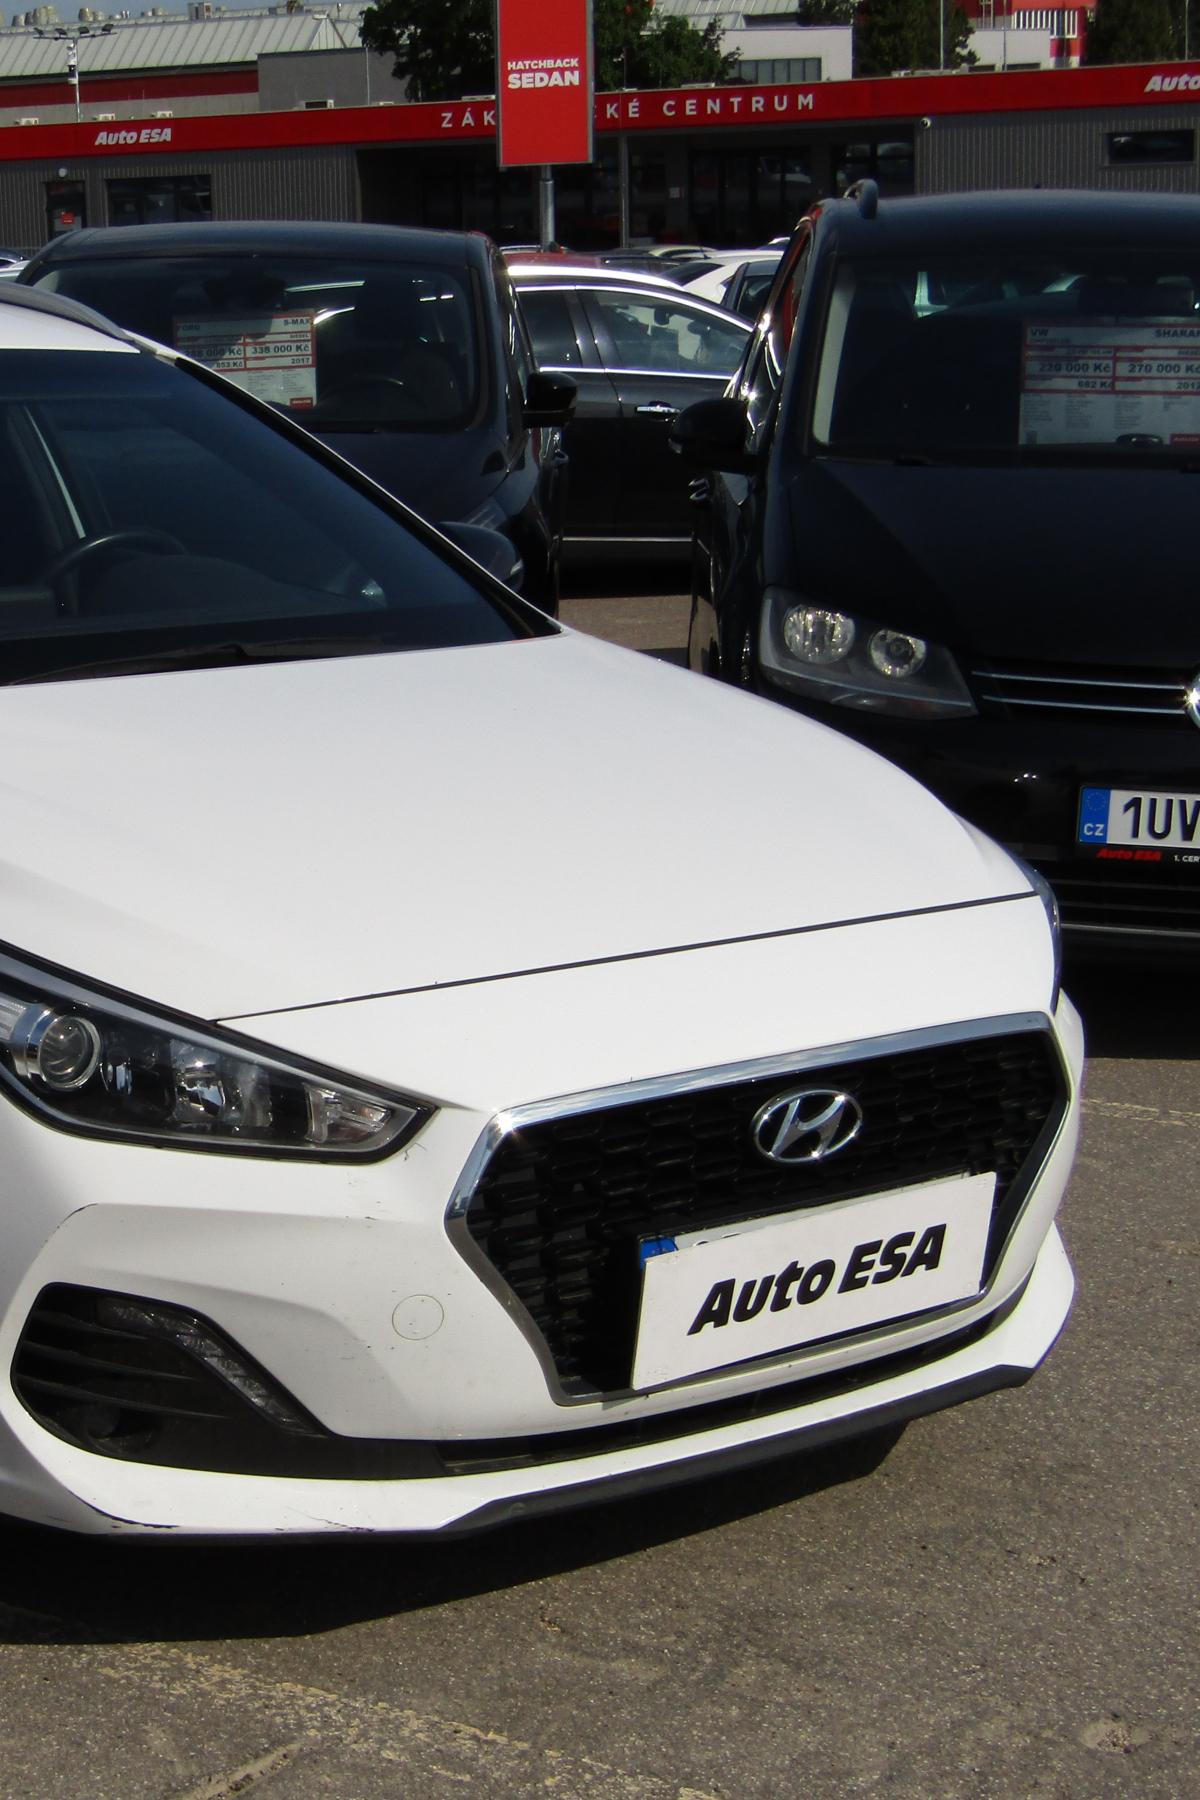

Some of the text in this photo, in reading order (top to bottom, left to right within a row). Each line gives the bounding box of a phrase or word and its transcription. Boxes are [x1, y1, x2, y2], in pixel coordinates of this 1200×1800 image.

[507, 58, 579, 70] HATCHBACK
[507, 71, 579, 89] SEDAN
[1143, 74, 1200, 93] Auto
[662, 93, 814, 117] CENTRUM
[94, 128, 172, 146] Auto ESA
[1031, 328, 1049, 337] VW
[273, 344, 293, 353] 000
[295, 343, 310, 352] Kč
[1065, 362, 1090, 374] 000
[1127, 363, 1153, 373] 270
[1156, 363, 1181, 374] 000
[1122, 796, 1200, 842] 1UV
[1083, 823, 1105, 836] CZ
[1182, 854, 1200, 863] CER
[686, 1223, 947, 1336] Auto ESA
